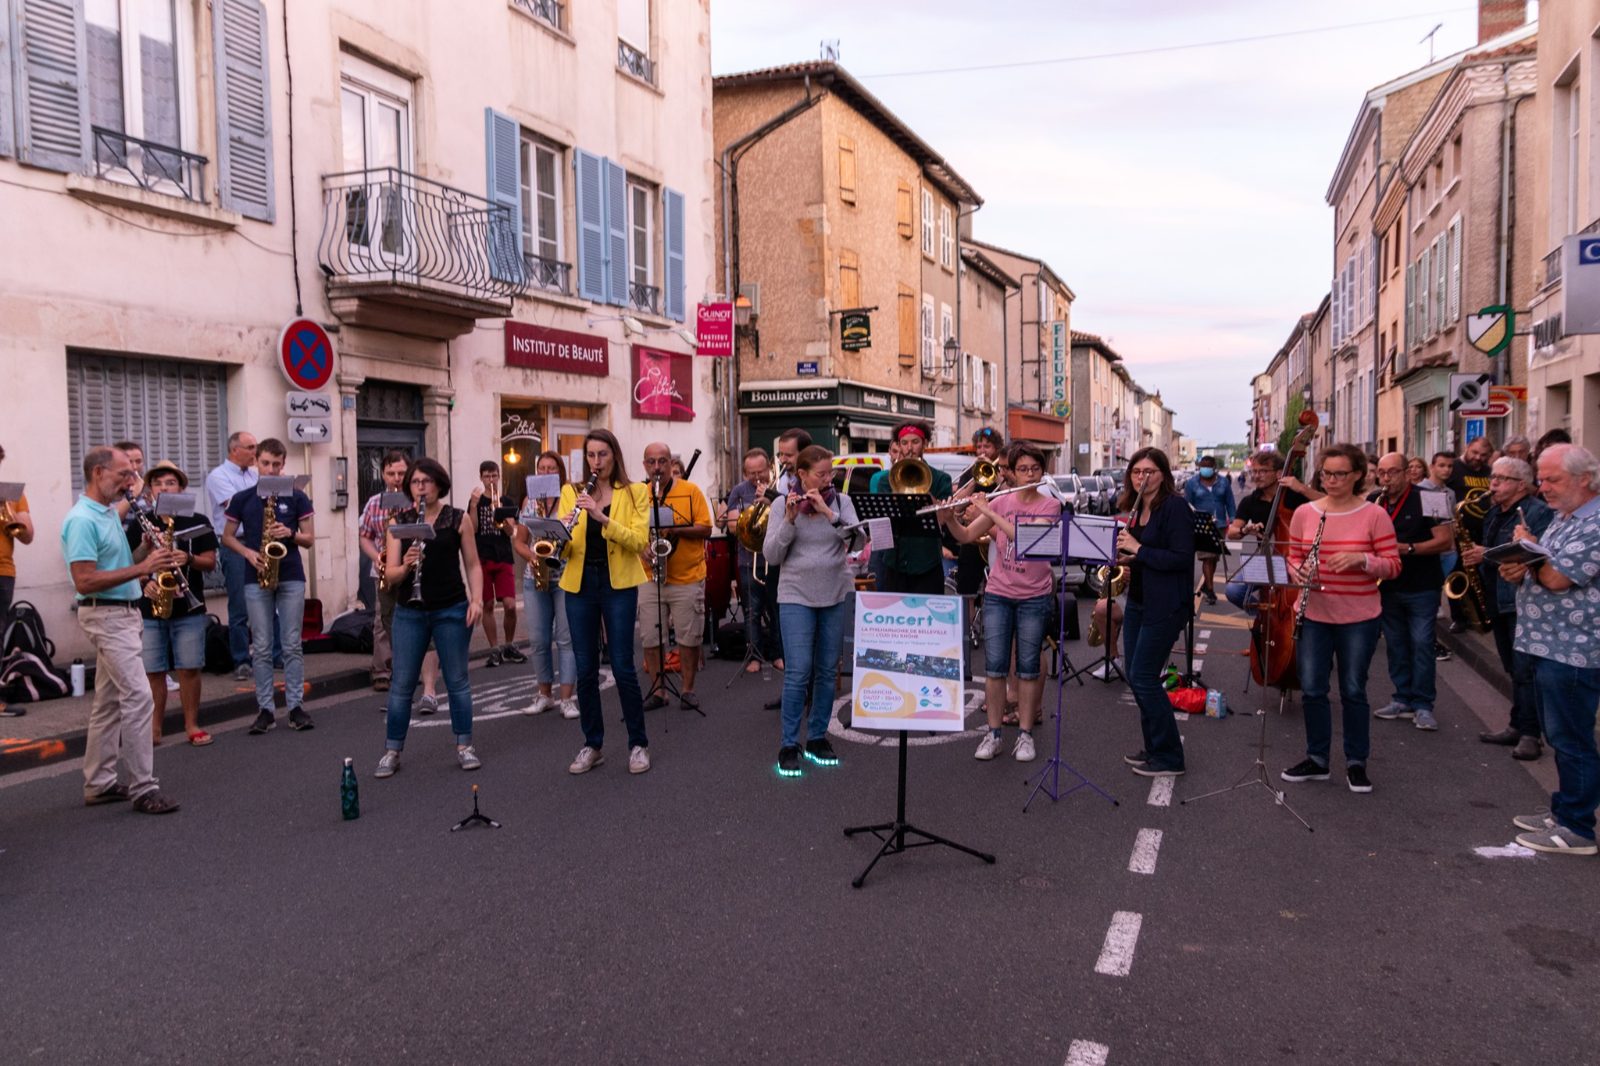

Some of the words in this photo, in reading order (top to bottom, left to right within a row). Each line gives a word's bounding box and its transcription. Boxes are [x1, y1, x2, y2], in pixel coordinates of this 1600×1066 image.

[699, 307, 731, 319] GUINOT
[700, 333, 728, 341] INSTITUT
[512, 335, 555, 357] INSTITUT
[558, 343, 570, 358] DE
[572, 343, 603, 363] BEAUTÉ
[707, 340, 730, 349] BEAUTÉ
[1053, 323, 1064, 400] FLEURS
[751, 389, 828, 402] Boulangerie
[863, 612, 933, 626] Concert
